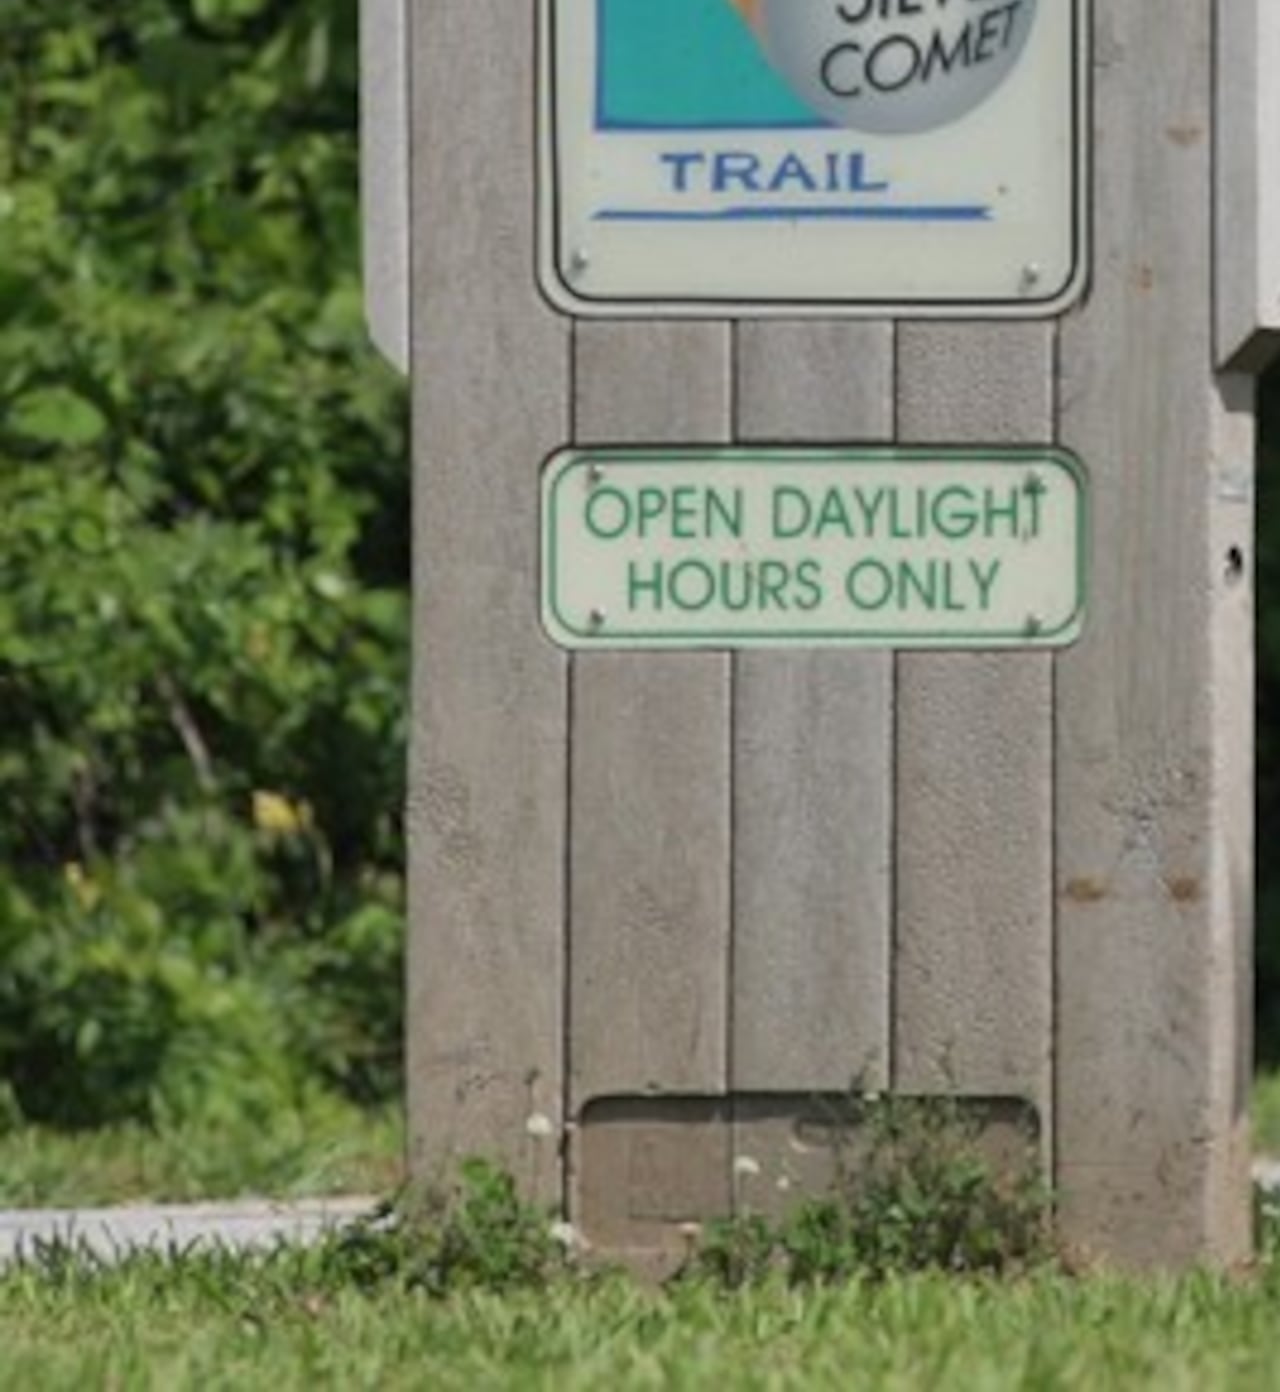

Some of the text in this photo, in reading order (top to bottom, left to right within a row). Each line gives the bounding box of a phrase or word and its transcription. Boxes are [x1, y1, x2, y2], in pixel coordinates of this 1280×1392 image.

[820, 0, 1022, 97] COMET
[659, 152, 889, 192] TRAIL
[584, 485, 1046, 539] OPEN DAYLIGHT
[627, 558, 1000, 611] HOURS ONLY
